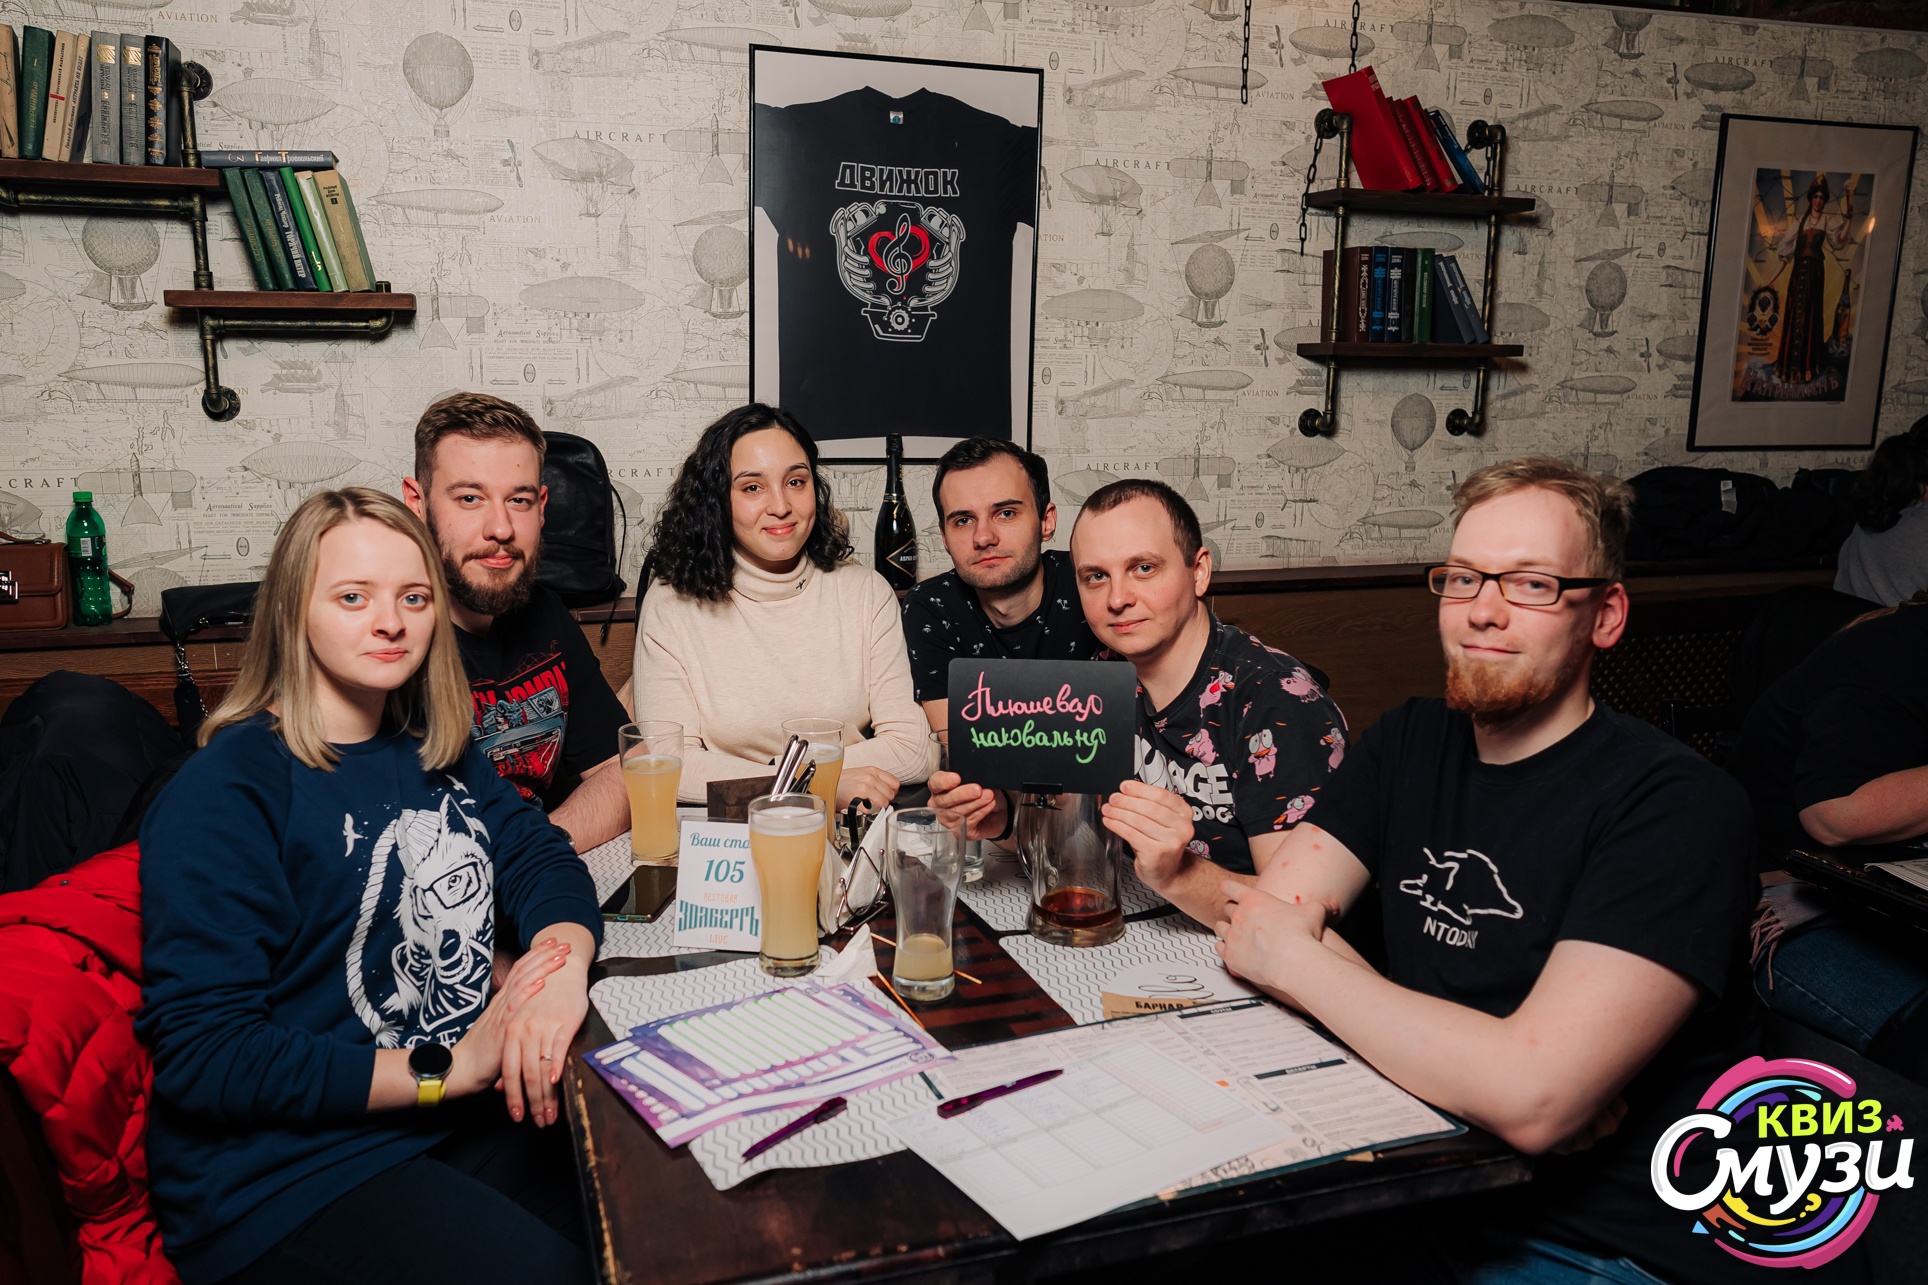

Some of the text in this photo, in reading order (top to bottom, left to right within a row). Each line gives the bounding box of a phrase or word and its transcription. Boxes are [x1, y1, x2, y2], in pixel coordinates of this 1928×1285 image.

[157, 10, 219, 23] AVIATION
[1256, 90, 1294, 100] AVIATION
[573, 130, 668, 143] AIRCRAFT
[1094, 157, 1171, 171] AIRCRAFT
[835, 162, 960, 197] ДВИЖОК
[489, 214, 541, 224] AVIATION
[1038, 233, 1064, 242] ATION
[1241, 389, 1279, 398] AVIATION
[608, 467, 674, 479] RCRAFT
[1086, 462, 1160, 472] AIRCRAFT
[8, 477, 79, 489] CRAFT
[205, 503, 272, 511] Aeronautical Supplies
[961, 671, 1103, 722] Плюшевая
[970, 720, 1107, 764] наковальня
[690, 832, 751, 849] Ваш сто
[704, 859, 746, 884] 105
[703, 892, 738, 903] RESTOBAR
[709, 934, 728, 944] LIVE
